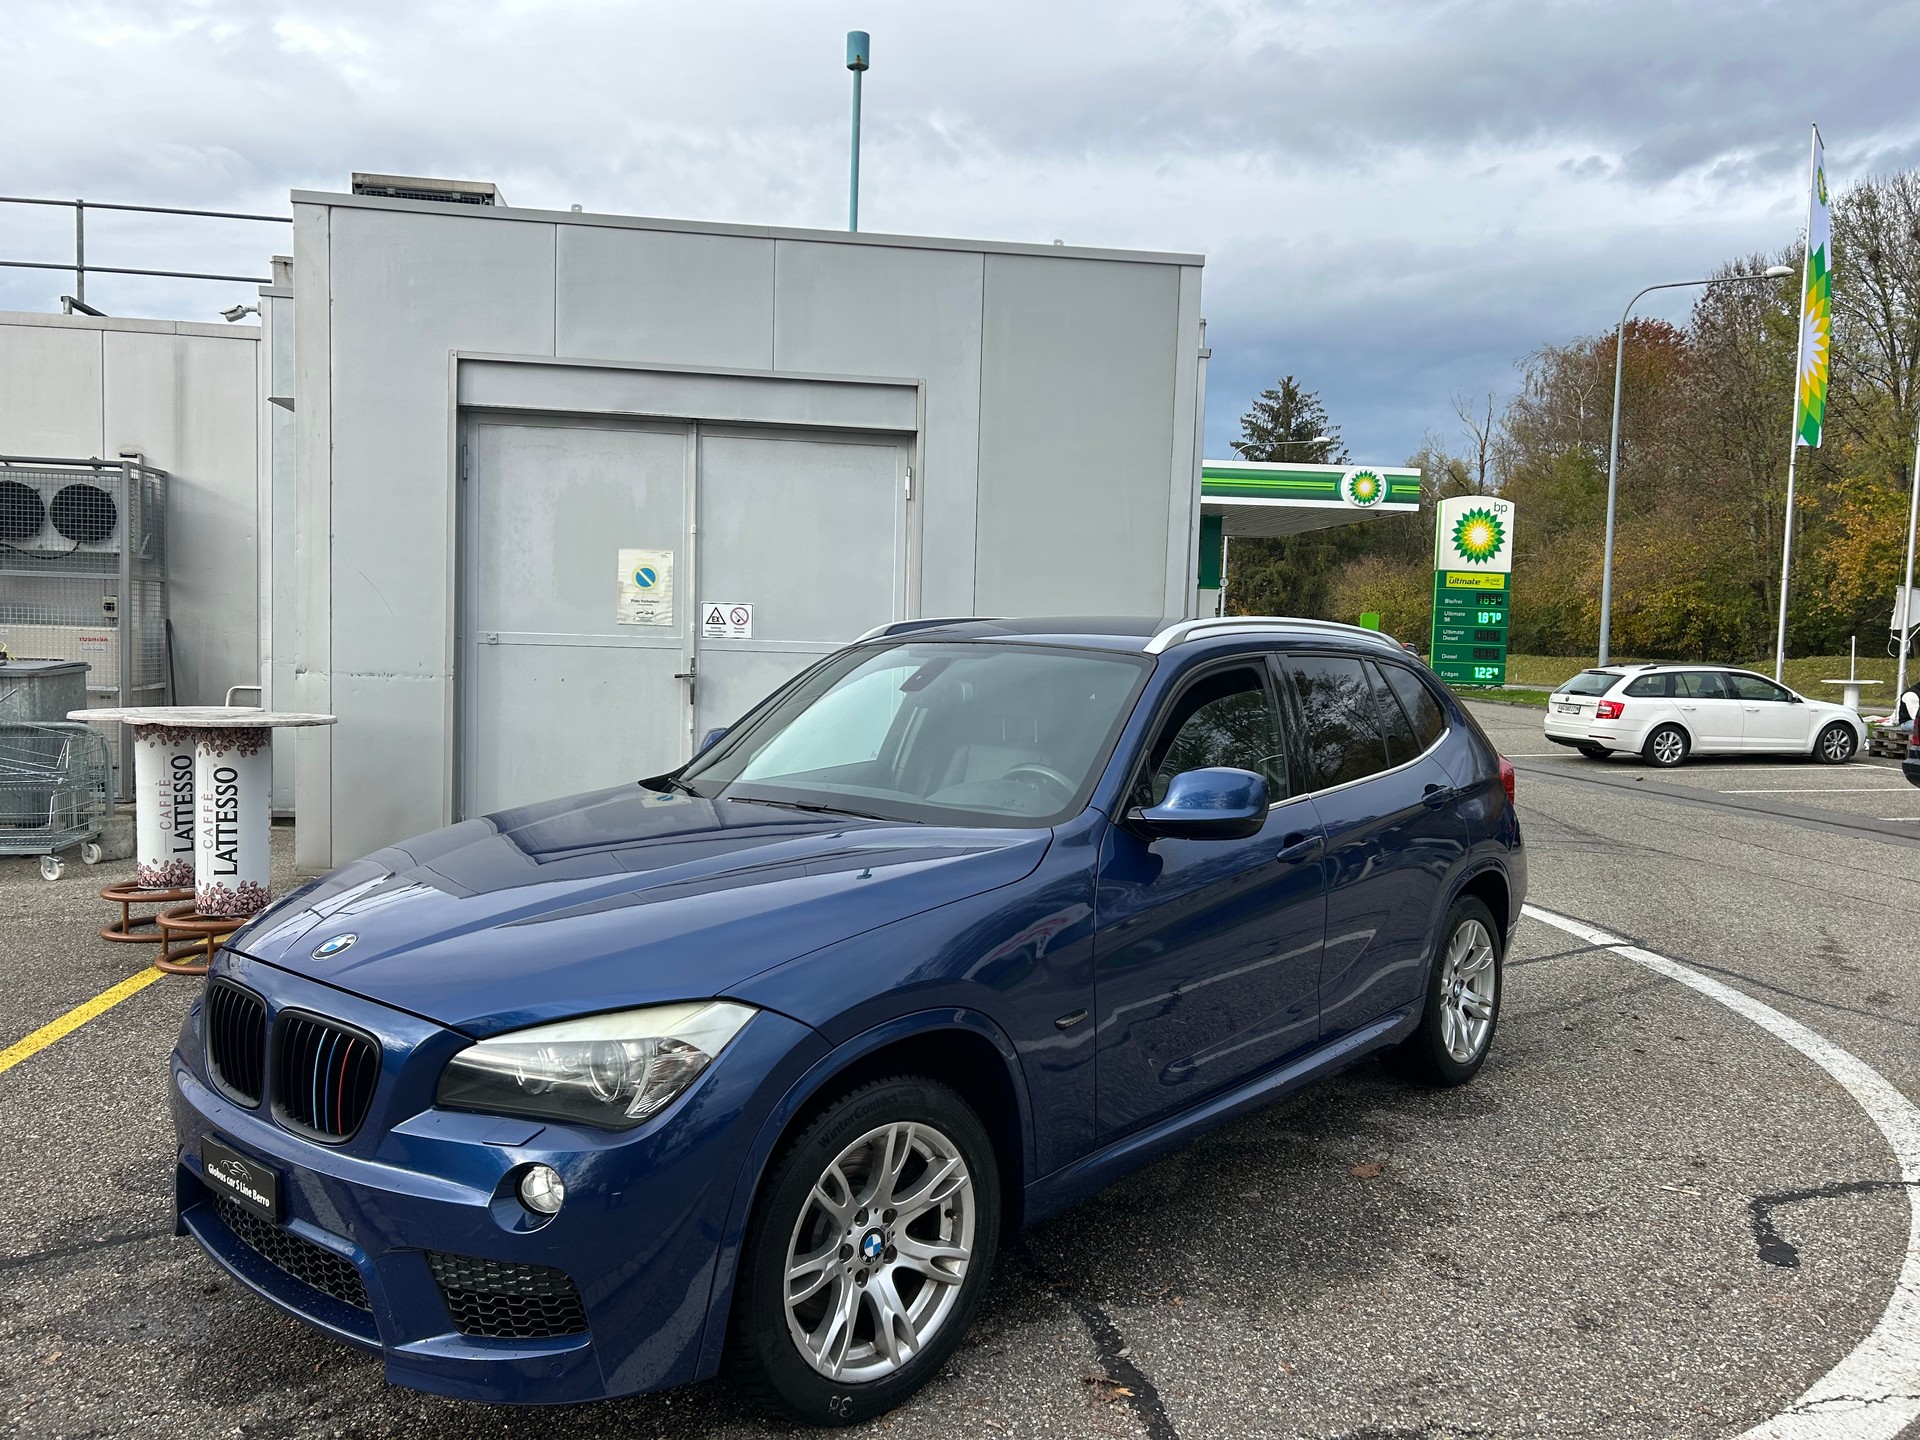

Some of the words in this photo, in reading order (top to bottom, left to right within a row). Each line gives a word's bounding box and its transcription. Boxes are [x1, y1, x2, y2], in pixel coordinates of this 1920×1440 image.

[1494, 502, 1508, 515] bp
[1449, 577, 1481, 586] ultimate
[155, 779, 173, 830] CAFFÈ
[170, 755, 194, 854] LATTESSO
[201, 793, 214, 849] CAFFÈ
[213, 767, 239, 876] LATTESSO
[208, 1163, 227, 1183] Globus
[240, 1181, 253, 1198] Line
[252, 1189, 270, 1207] Berro
